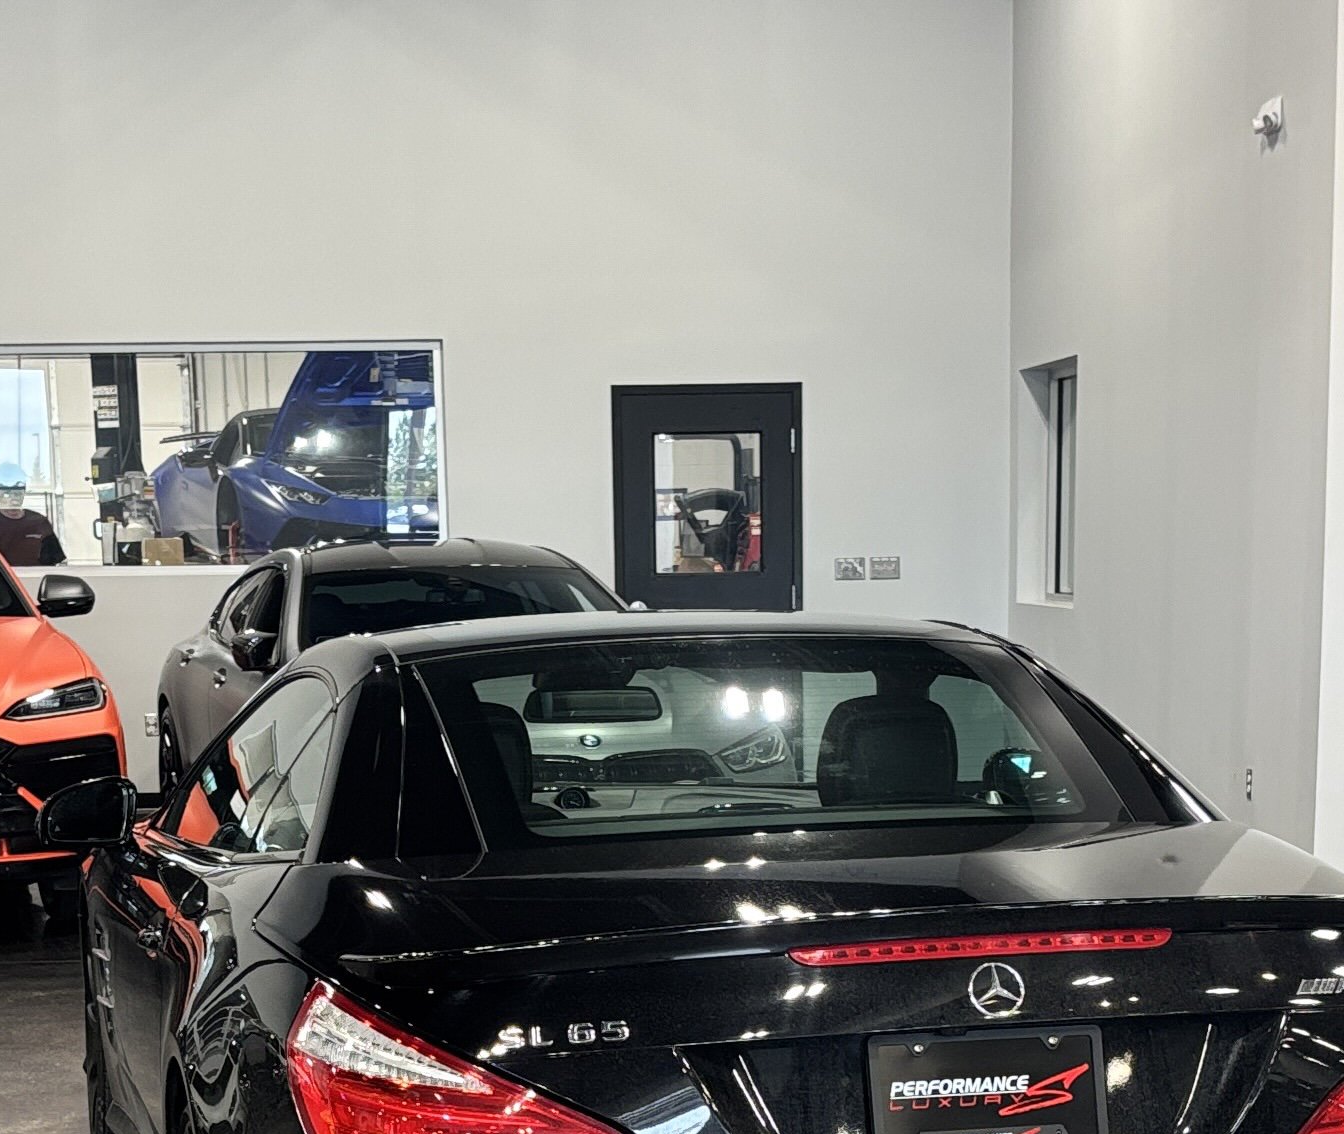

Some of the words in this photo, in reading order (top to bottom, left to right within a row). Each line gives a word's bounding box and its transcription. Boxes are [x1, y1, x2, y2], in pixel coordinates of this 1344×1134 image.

[498, 1024, 554, 1048] SL
[567, 1019, 630, 1044] 65
[889, 1074, 1030, 1097] PERFORMANCE
[889, 1093, 1025, 1111] LUXURY
